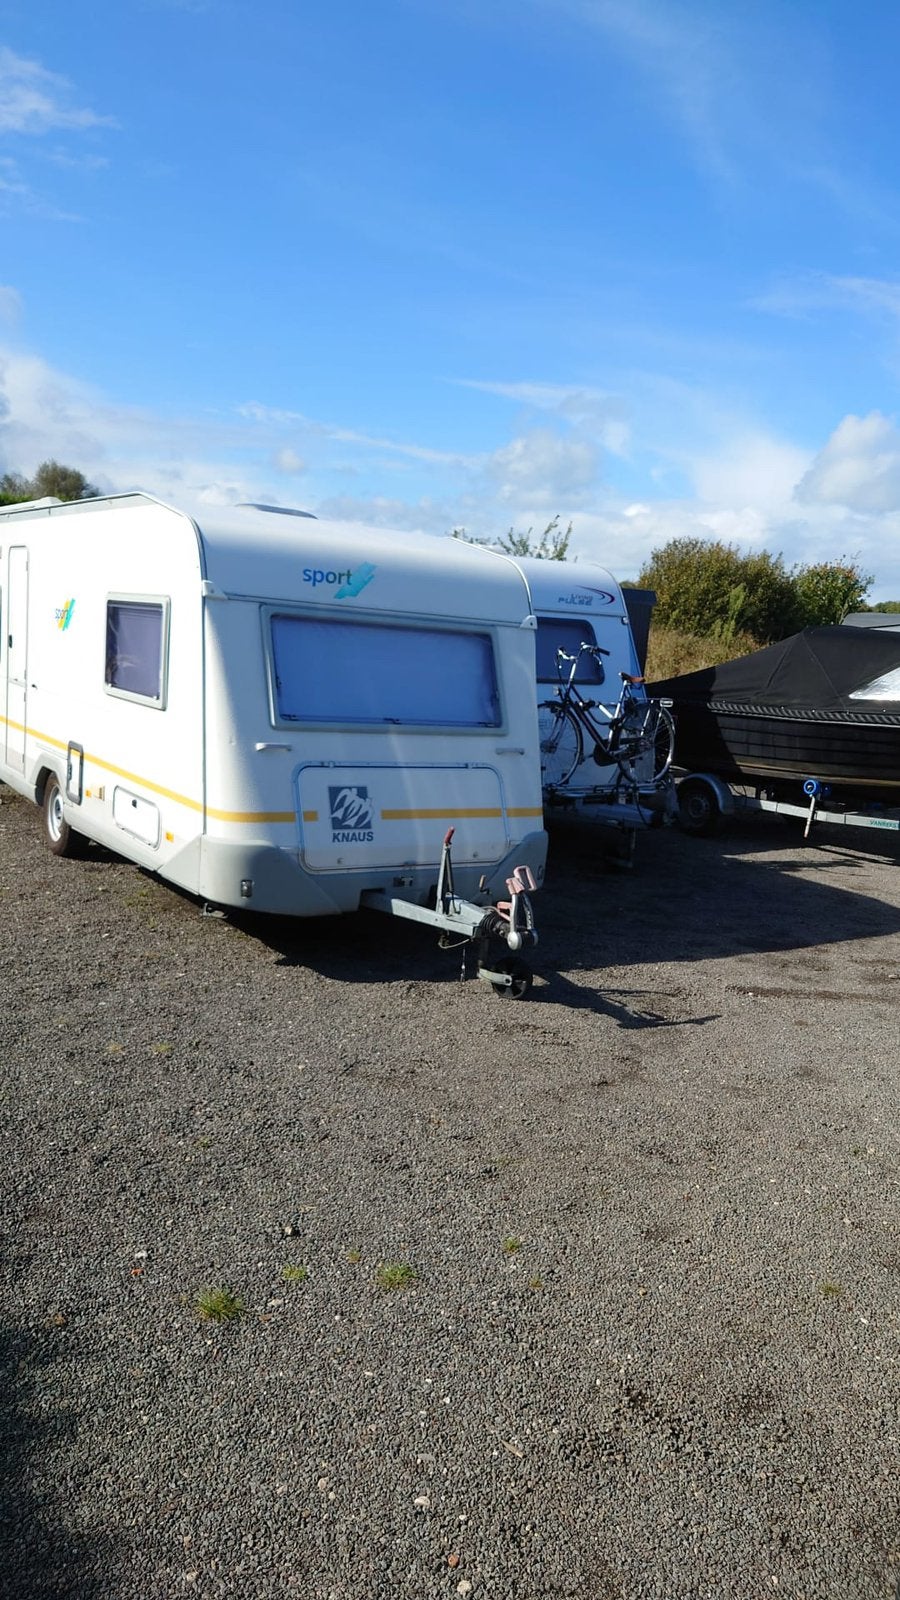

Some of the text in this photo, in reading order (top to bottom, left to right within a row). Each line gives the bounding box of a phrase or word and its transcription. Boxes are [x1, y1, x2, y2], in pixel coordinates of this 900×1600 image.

[302, 568, 352, 587] sport
[558, 596, 592, 606] PULSE
[332, 831, 374, 843] KNAUS
